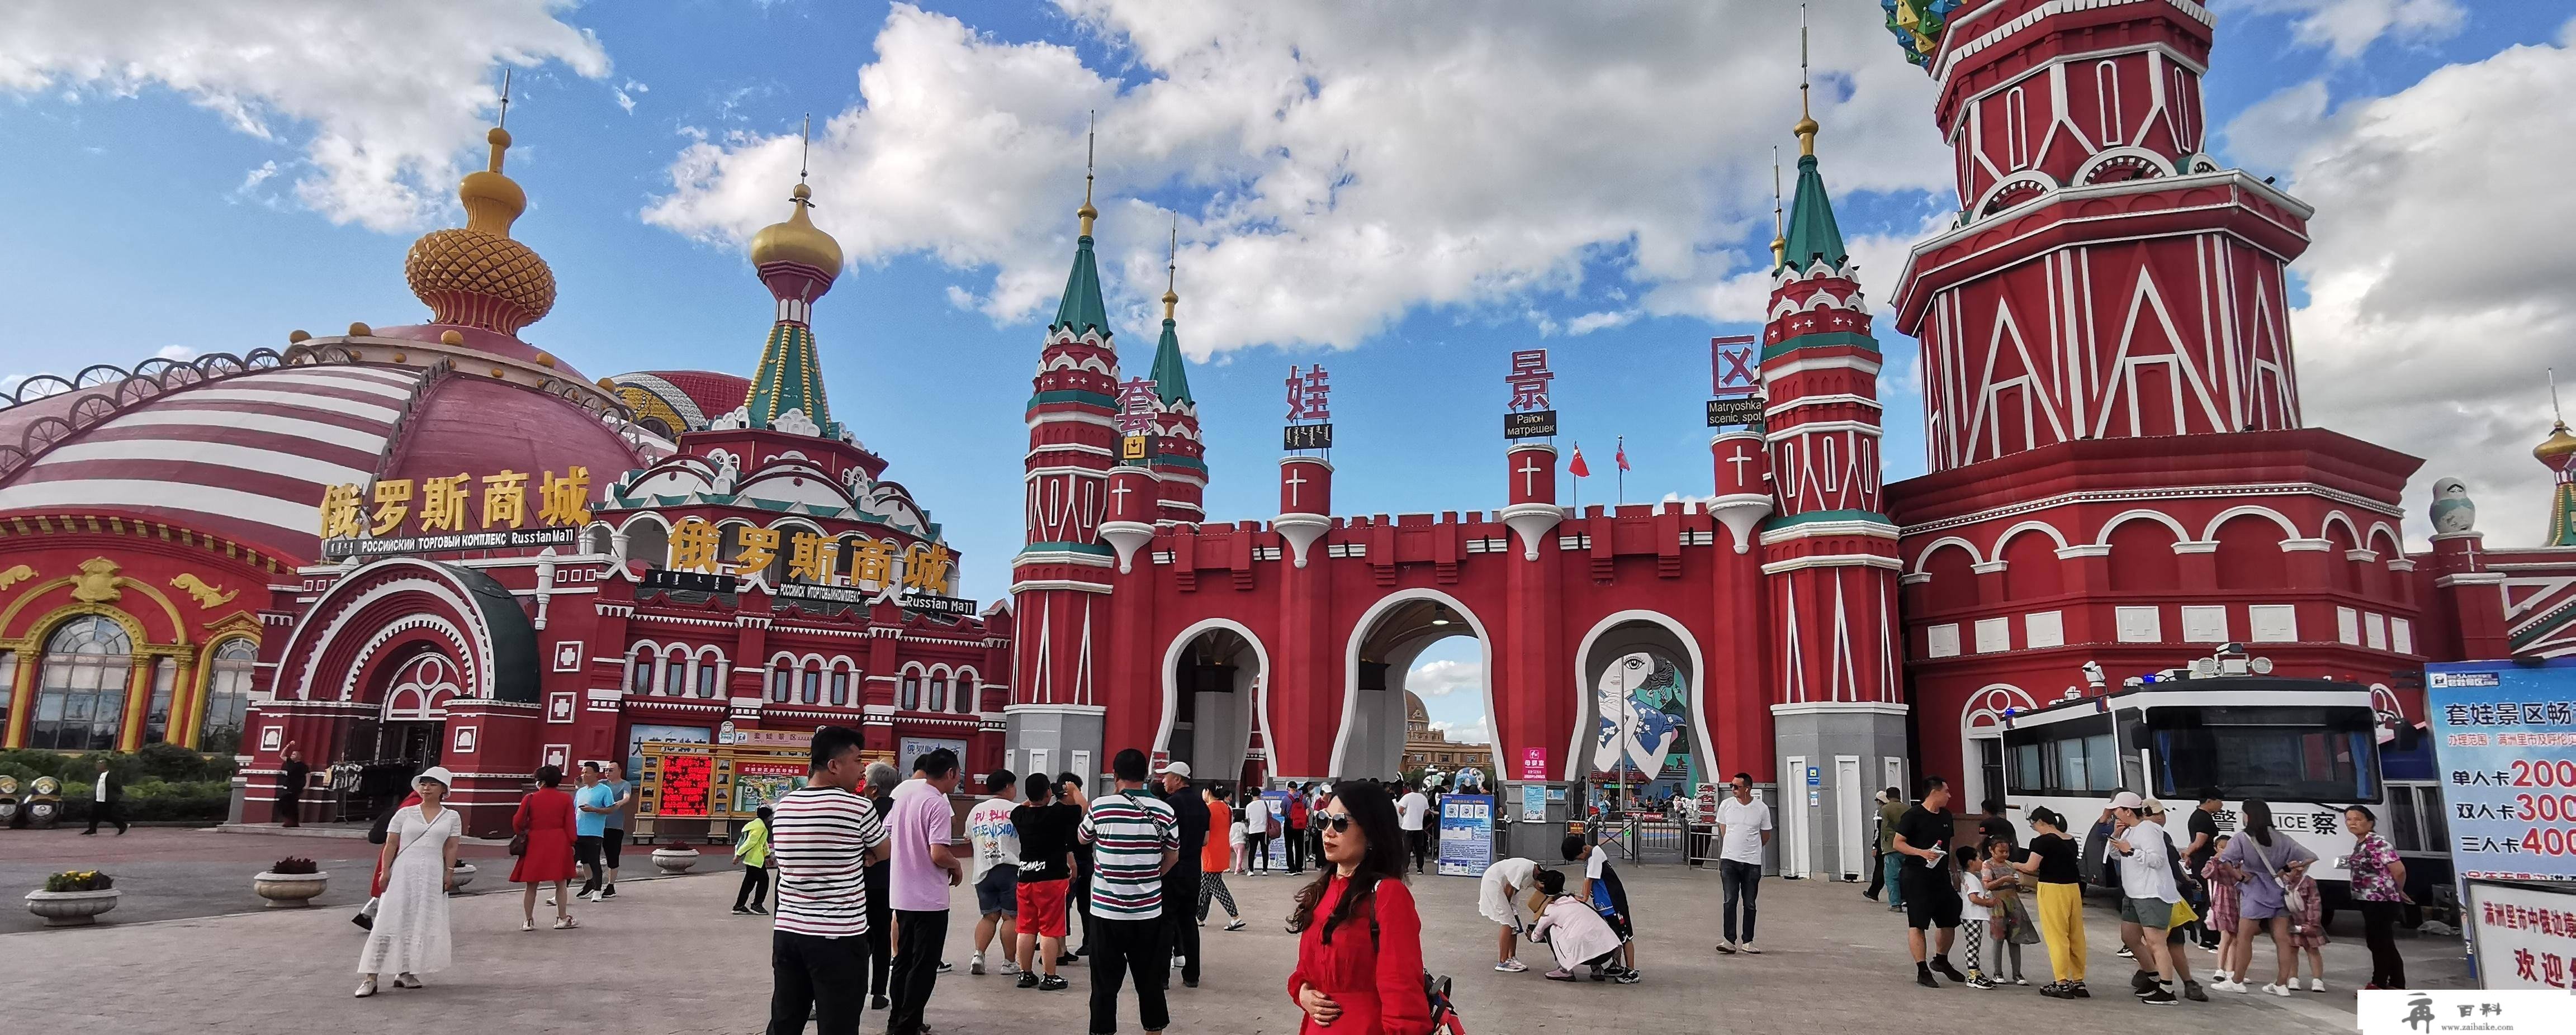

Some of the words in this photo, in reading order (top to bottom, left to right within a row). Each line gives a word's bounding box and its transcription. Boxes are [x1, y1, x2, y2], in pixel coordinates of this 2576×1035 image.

[1114, 376, 1158, 433] 套
[1285, 363, 1330, 421] 娃
[1505, 349, 1554, 410] 景
[1711, 335, 1760, 396] 区
[1709, 401, 1761, 413] Matryoshka
[1710, 414, 1738, 424] scenic
[1742, 411, 1761, 423] spot
[1517, 415, 1543, 424] Район
[320, 466, 591, 539] 俄罗斯商城
[362, 538, 415, 553] РОССИЙСКИЙ
[419, 535, 460, 549] ТОРГОВЫЙ
[462, 533, 506, 547] КОМПЛЕКС
[669, 519, 949, 594] 俄罗斯商城
[907, 596, 947, 610] Russian
[951, 601, 973, 614] Mall
[2445, 702, 2576, 725] 套娃景区畅
[2212, 809, 2237, 832] 警
[2274, 816, 2307, 828] ICE
[2312, 811, 2337, 835] 察
[2513, 948, 2576, 989] 欢迎
